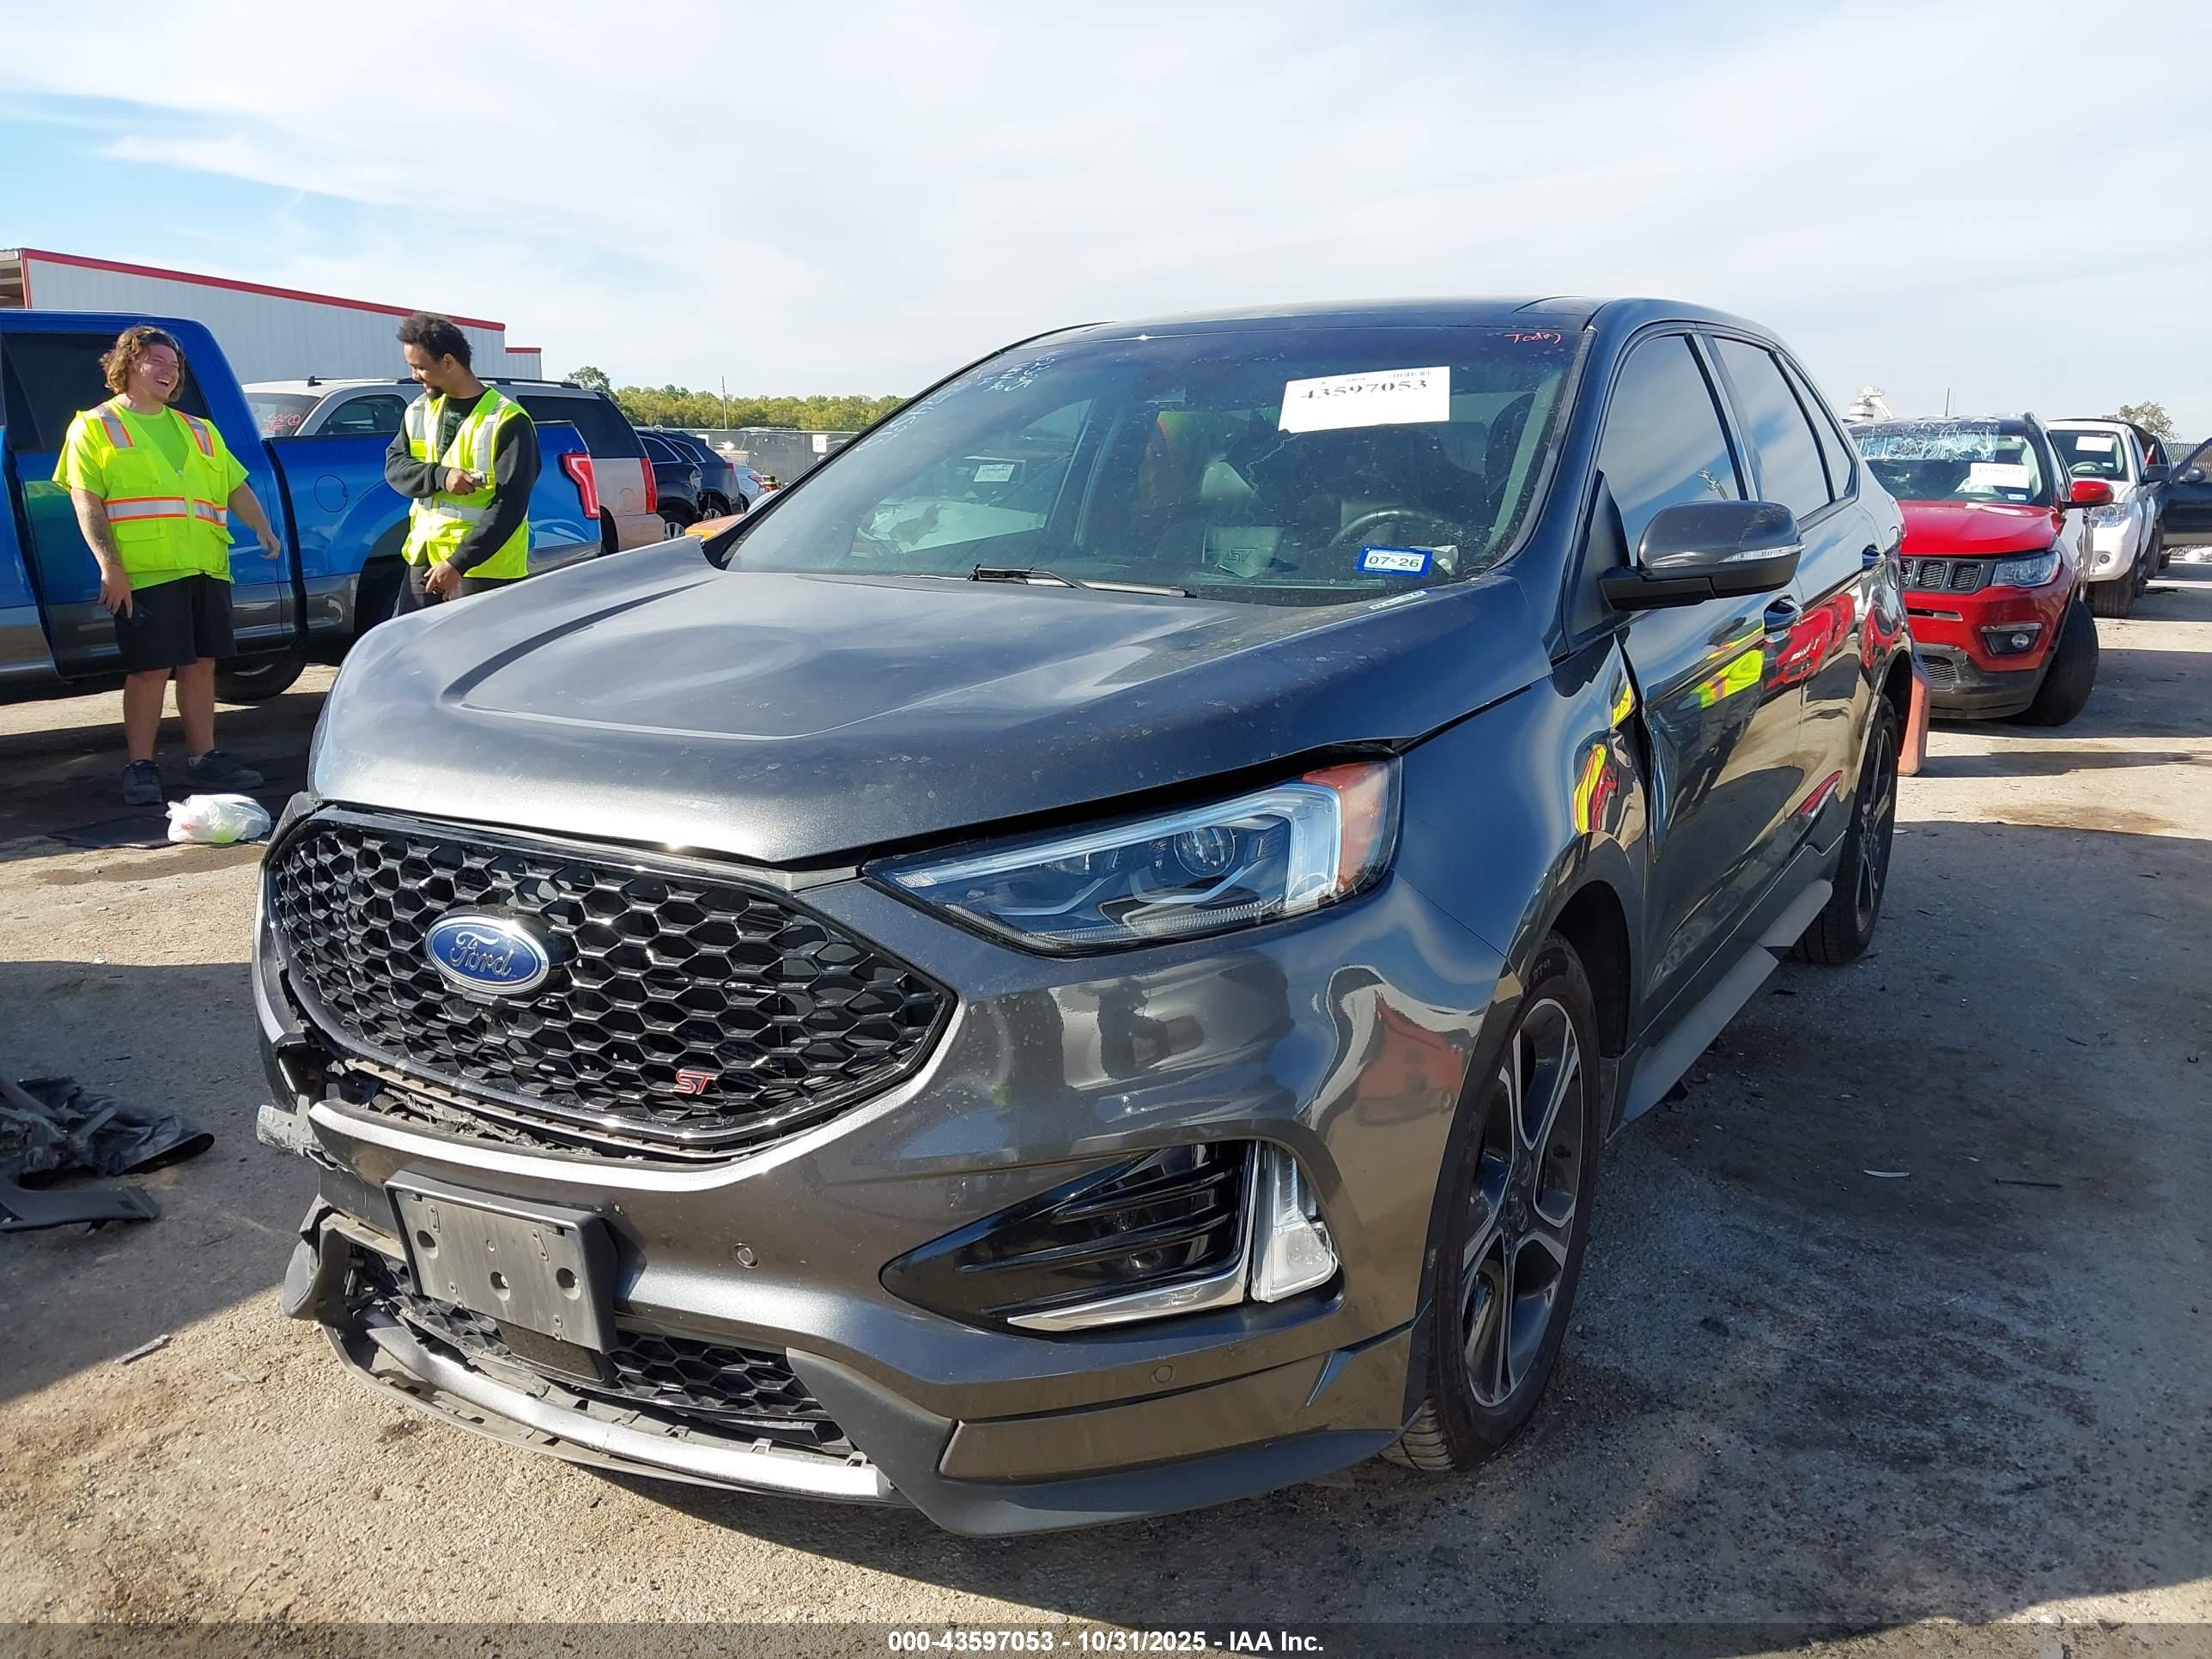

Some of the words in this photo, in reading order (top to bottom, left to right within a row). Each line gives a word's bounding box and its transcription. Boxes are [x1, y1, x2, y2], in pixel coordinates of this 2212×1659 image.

[1299, 379, 1428, 399] 43597053
[449, 931, 514, 977] Ford
[672, 1068, 719, 1096] ST
